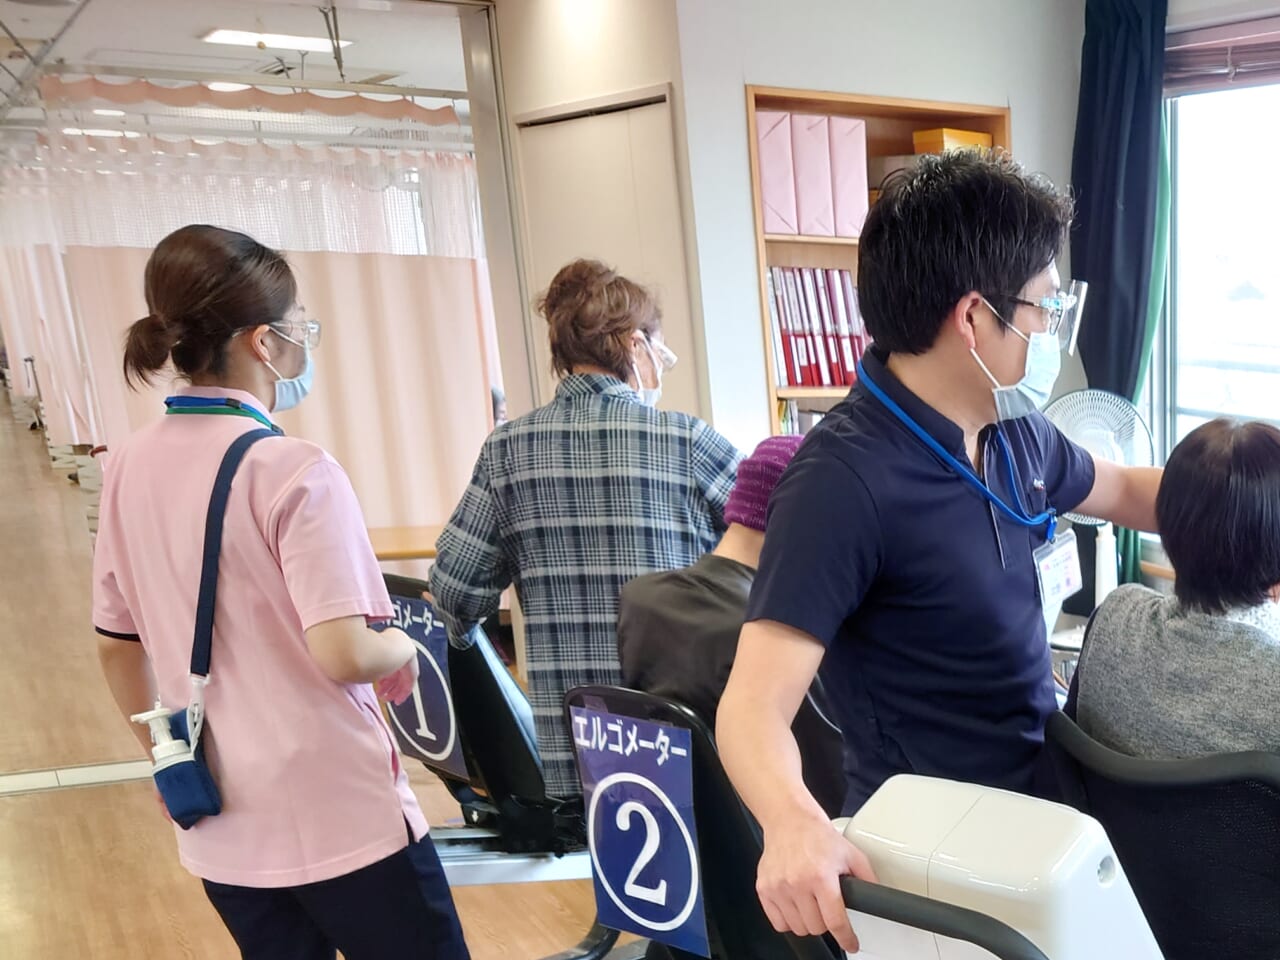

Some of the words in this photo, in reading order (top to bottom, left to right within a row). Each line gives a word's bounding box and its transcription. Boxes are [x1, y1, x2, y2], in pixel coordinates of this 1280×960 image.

[384, 600, 445, 637] ゴメーター
[574, 715, 687, 766] エルゴメーター
